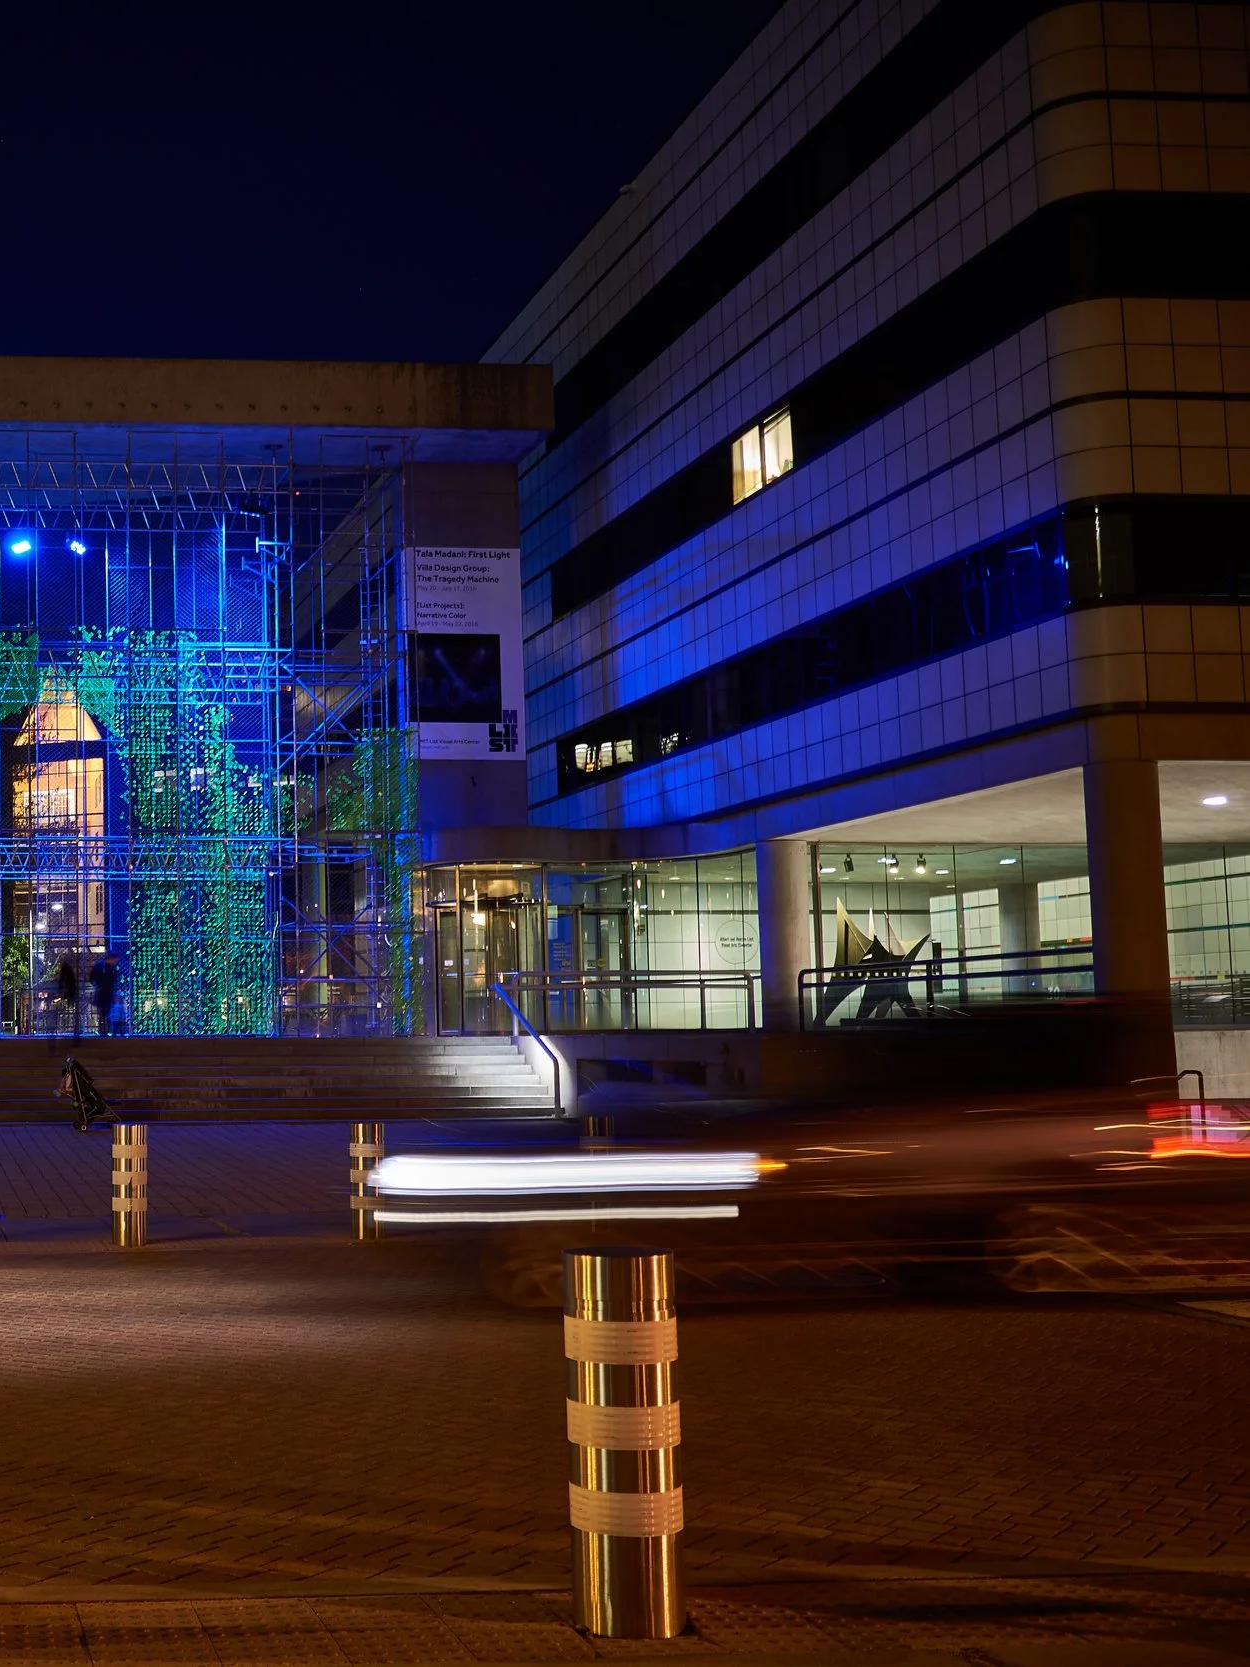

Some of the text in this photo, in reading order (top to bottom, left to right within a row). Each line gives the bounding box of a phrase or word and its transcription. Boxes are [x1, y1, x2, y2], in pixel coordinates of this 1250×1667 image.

[416, 549, 511, 561] Tala Madani: First Light
[416, 564, 490, 573] Villa Design Group:
[417, 574, 500, 585] The Tragedy Machine
